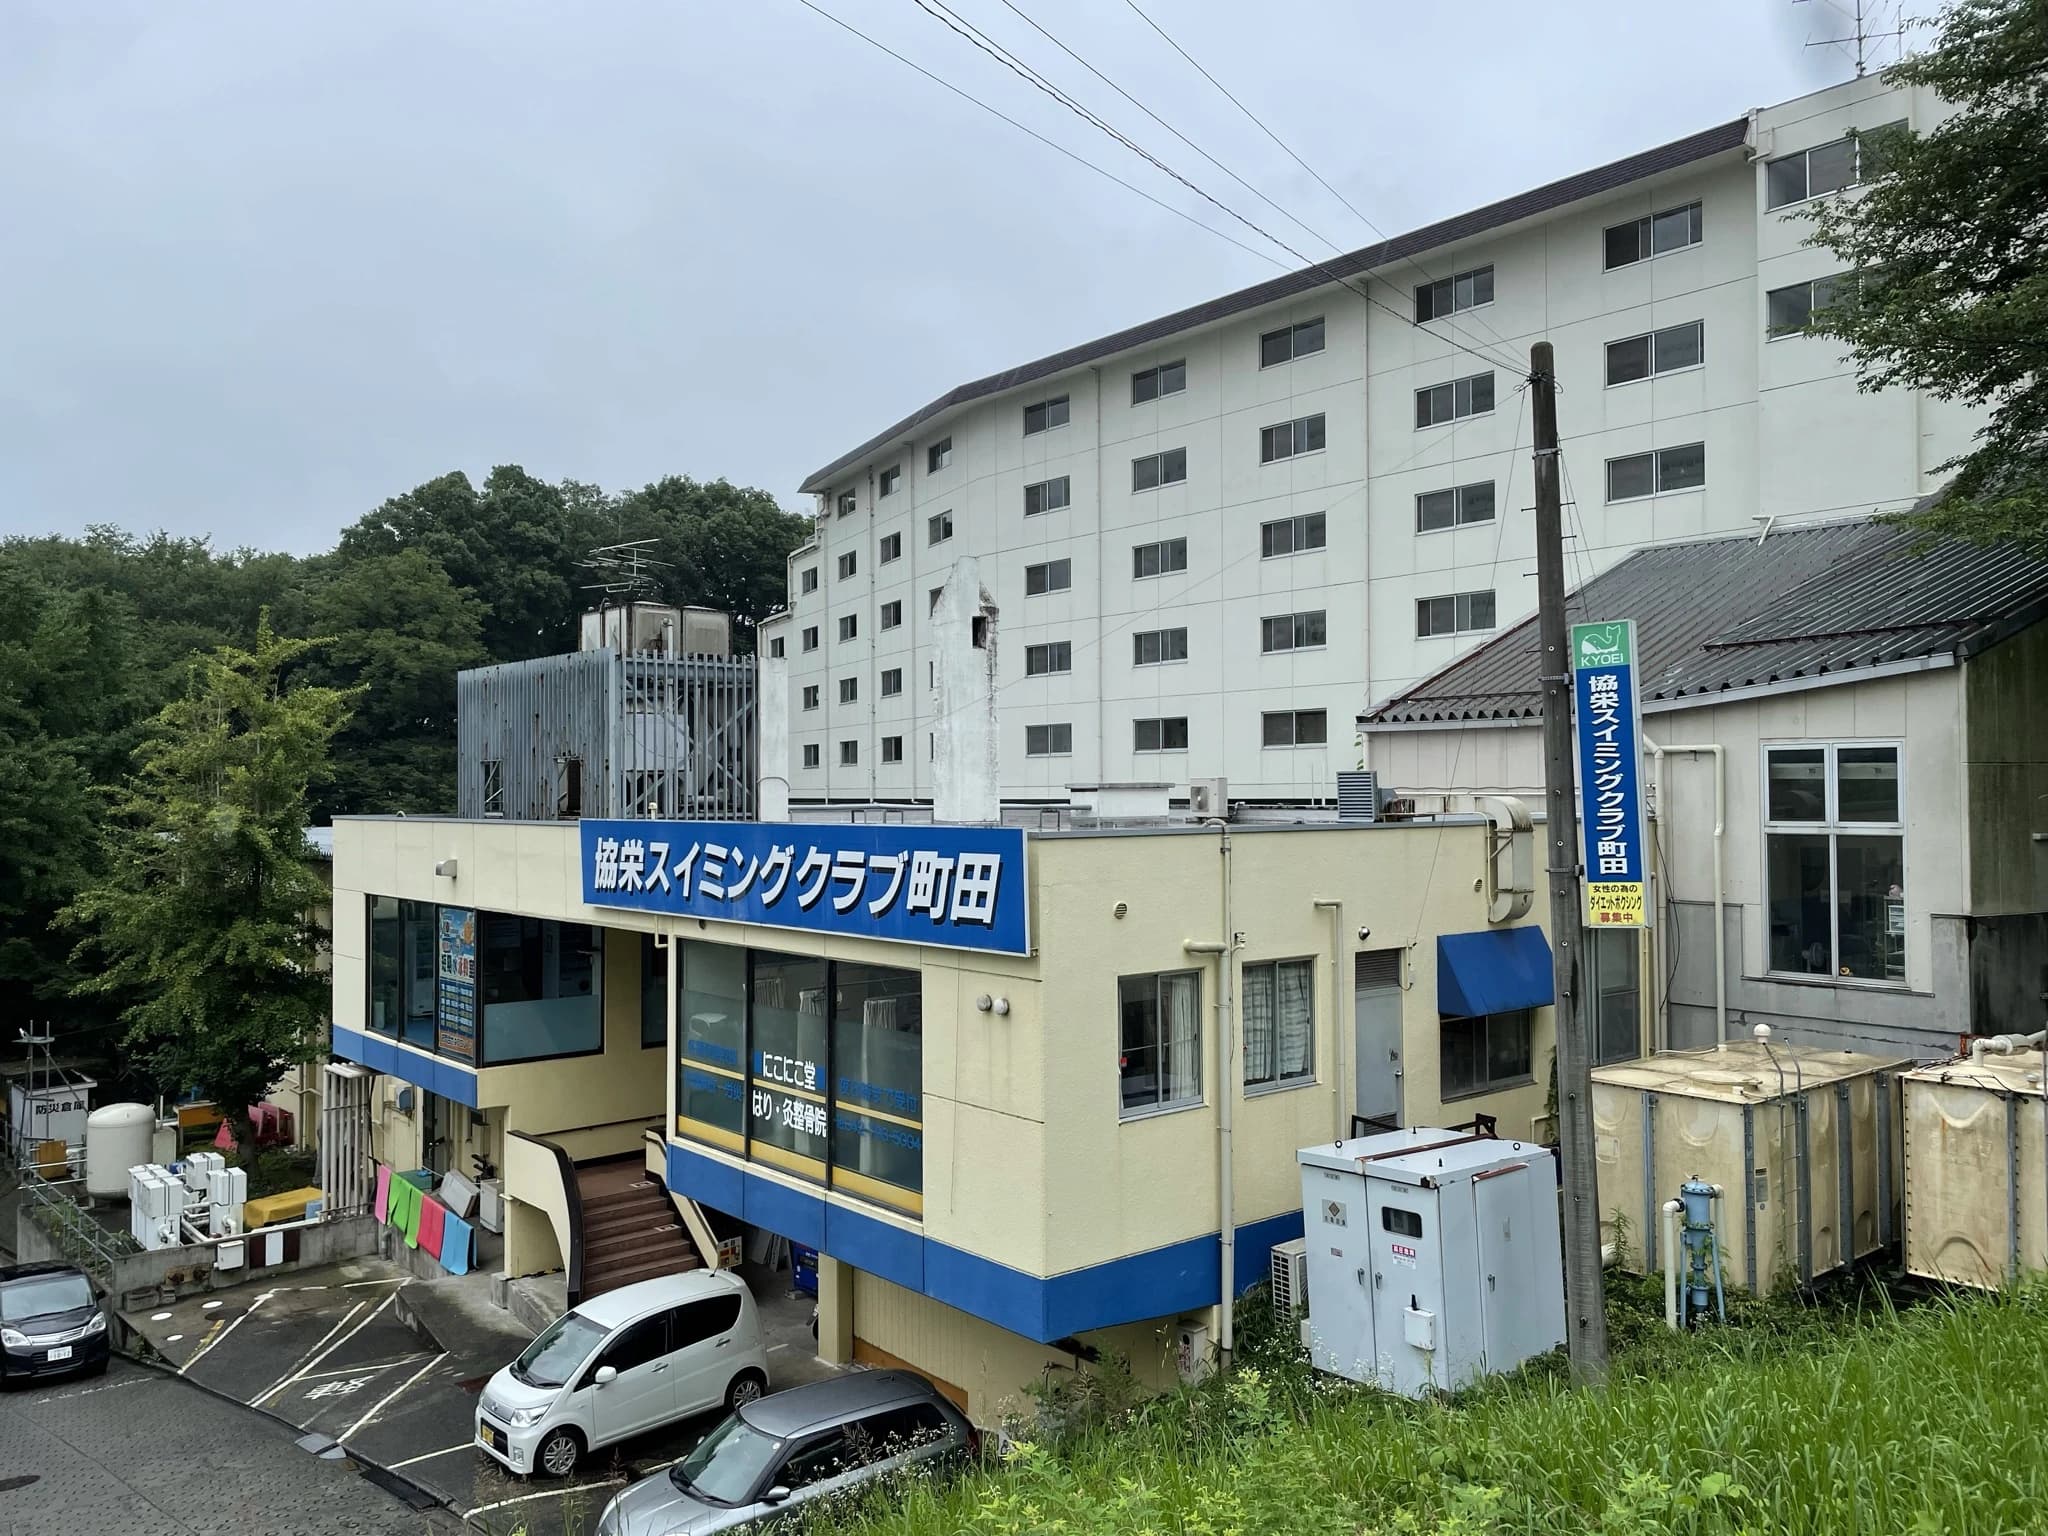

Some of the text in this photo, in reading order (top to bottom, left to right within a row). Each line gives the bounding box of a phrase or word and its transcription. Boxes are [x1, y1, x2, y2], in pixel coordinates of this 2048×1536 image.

[1581, 653, 1623, 667] KYOEI
[1589, 674, 1628, 875] 協栄スイミングクラブ町田
[594, 836, 1001, 924] 協栄スイミングクラブ町田
[1592, 884, 1638, 894] 女性の為の
[1590, 895, 1642, 911] ダイエットボクシング
[1600, 912, 1633, 923] 募集中
[763, 1050, 816, 1091] にこにこ堂
[752, 1089, 827, 1138] はり・灸整骨院
